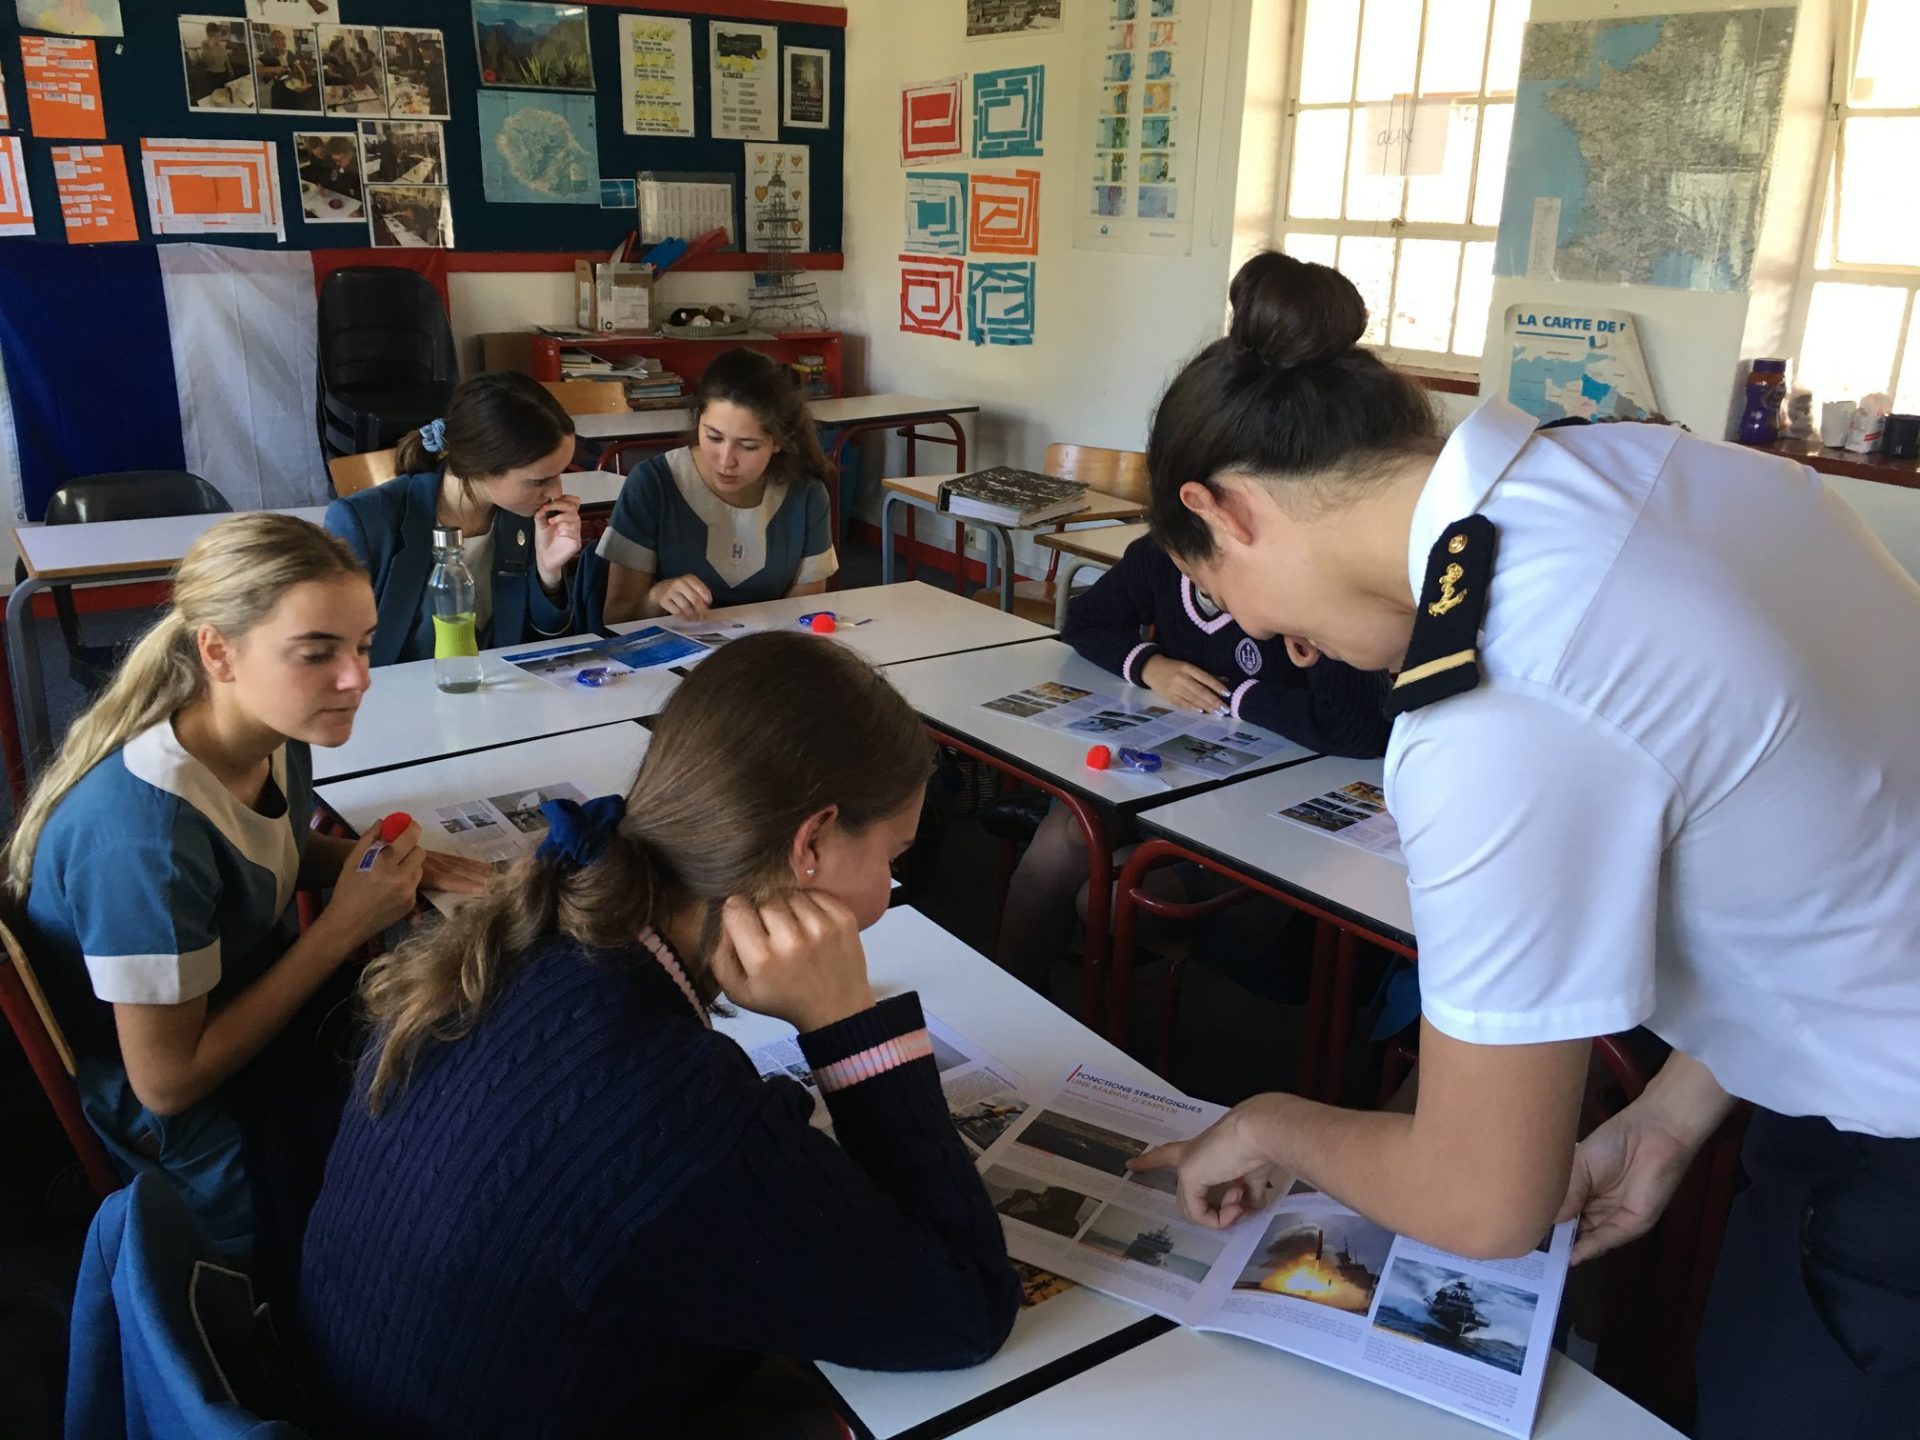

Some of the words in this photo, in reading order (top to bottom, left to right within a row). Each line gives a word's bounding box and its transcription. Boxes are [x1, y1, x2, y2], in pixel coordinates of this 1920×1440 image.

[1517, 314, 1537, 326] LA
[1542, 315, 1592, 331] CARTE
[1597, 319, 1616, 333] DE
[1071, 1078, 1091, 1089] UNE
[1092, 1084, 1130, 1101] MARINE
[1131, 1096, 1179, 1115] D'EMPLOI
[1076, 1071, 1133, 1093] FONCTIONS
[1133, 1087, 1204, 1114] STRATÉGIQUES
